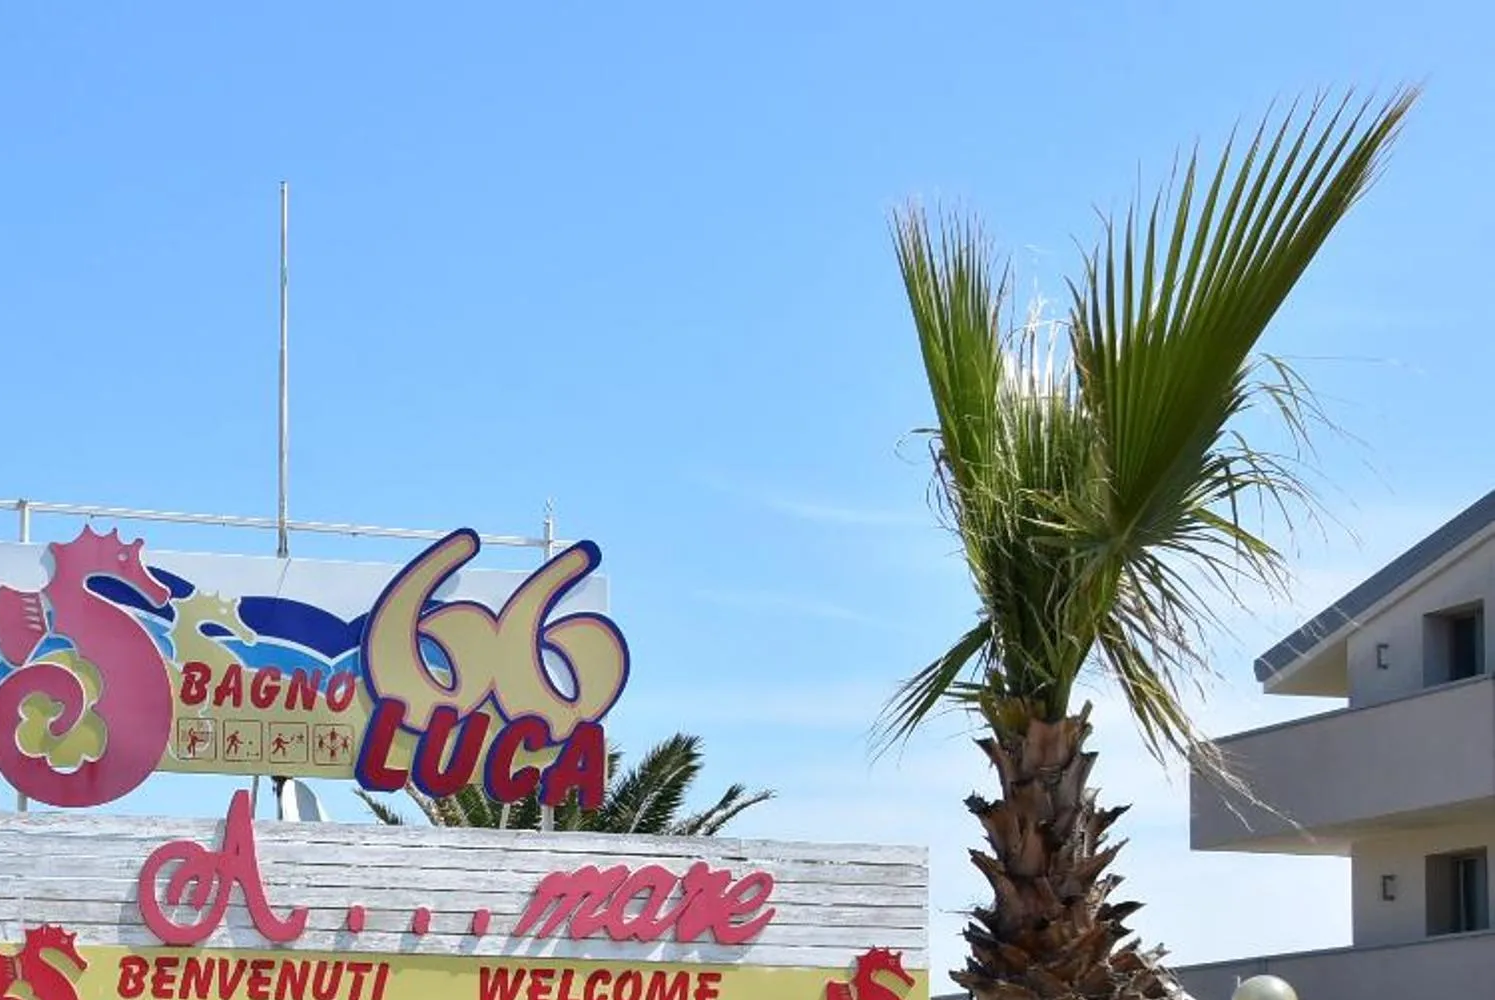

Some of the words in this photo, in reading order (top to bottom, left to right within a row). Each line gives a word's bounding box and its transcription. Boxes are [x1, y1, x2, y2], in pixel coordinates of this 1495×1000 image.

[361, 528, 630, 738] 66
[181, 661, 357, 712] BAGNO
[360, 698, 607, 810] LUCA
[514, 863, 775, 945] mare
